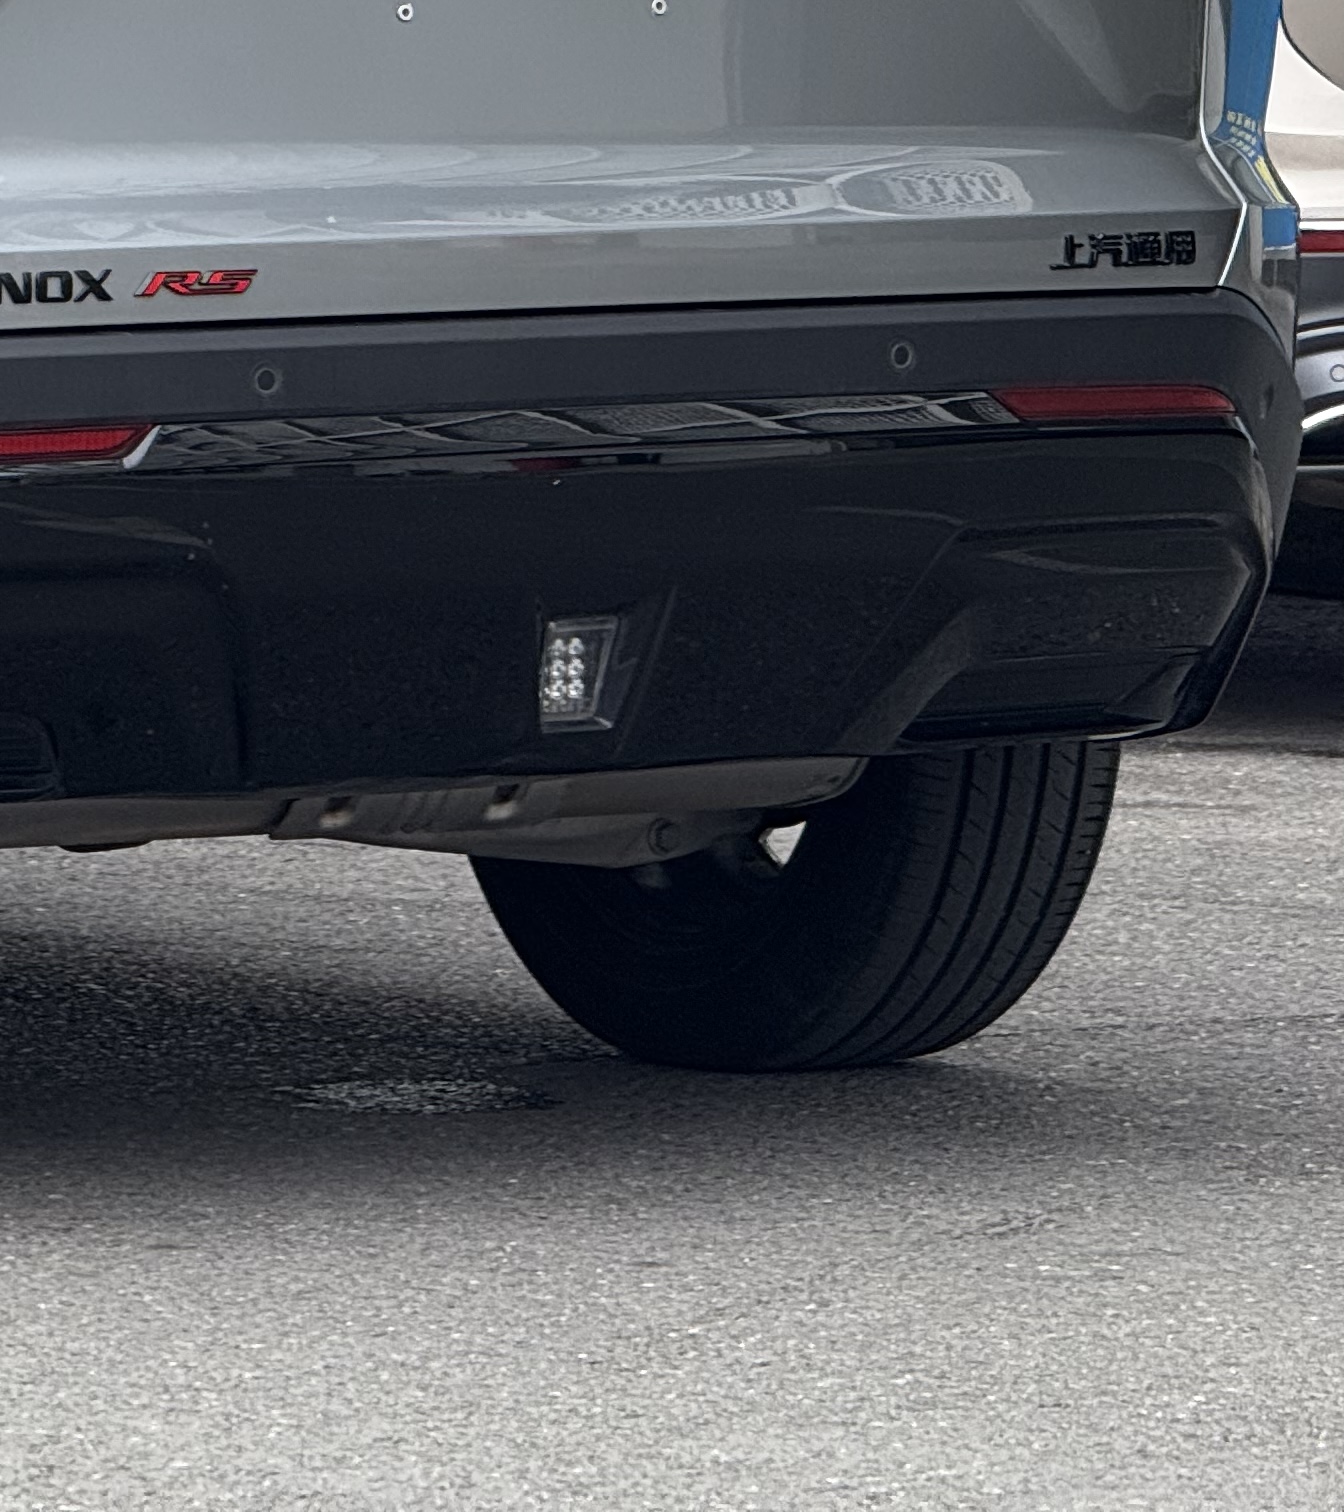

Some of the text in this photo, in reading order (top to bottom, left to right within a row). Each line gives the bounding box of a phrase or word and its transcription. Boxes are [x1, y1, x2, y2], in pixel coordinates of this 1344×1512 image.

[1049, 230, 1197, 271] 上汽通用
[133, 269, 258, 298] RS
